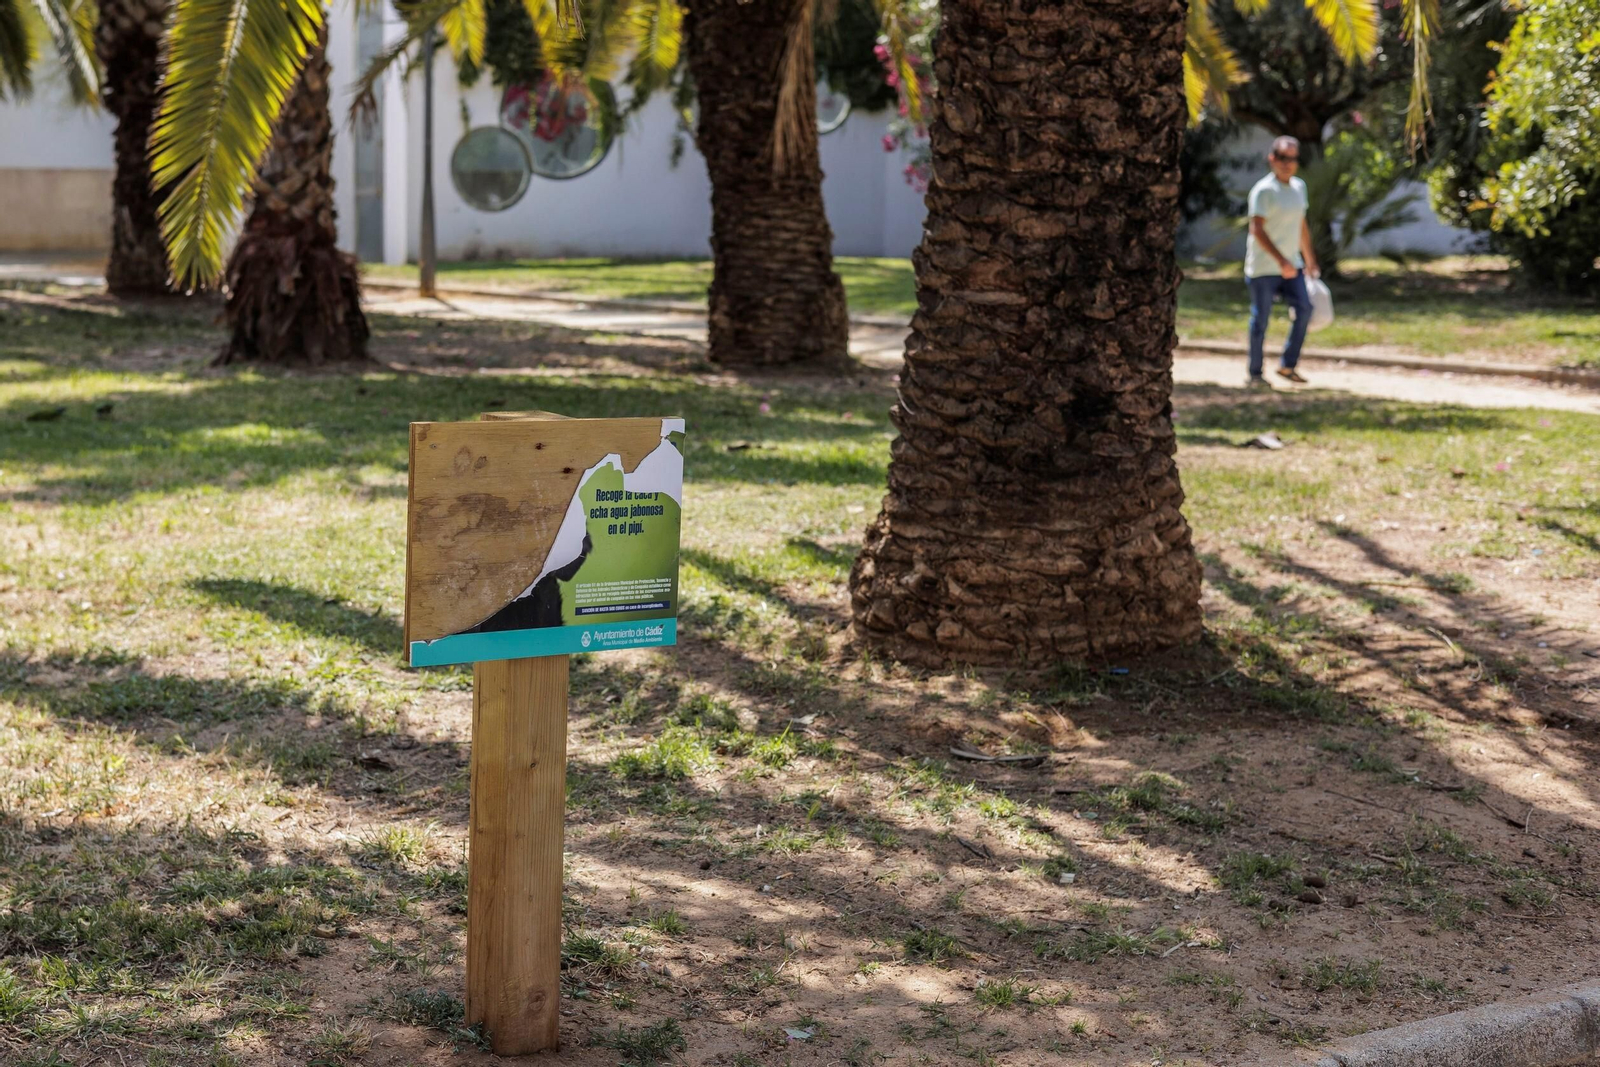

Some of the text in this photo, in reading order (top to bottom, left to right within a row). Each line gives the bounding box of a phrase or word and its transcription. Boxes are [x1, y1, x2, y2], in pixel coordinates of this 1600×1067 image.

[596, 489, 624, 502] Recoge
[626, 490, 632, 500] la
[590, 504, 664, 520] echa agua jabonosa
[608, 520, 644, 536] en el pipí.
[594, 626, 663, 642] Ayuntamiento de Cádiz
